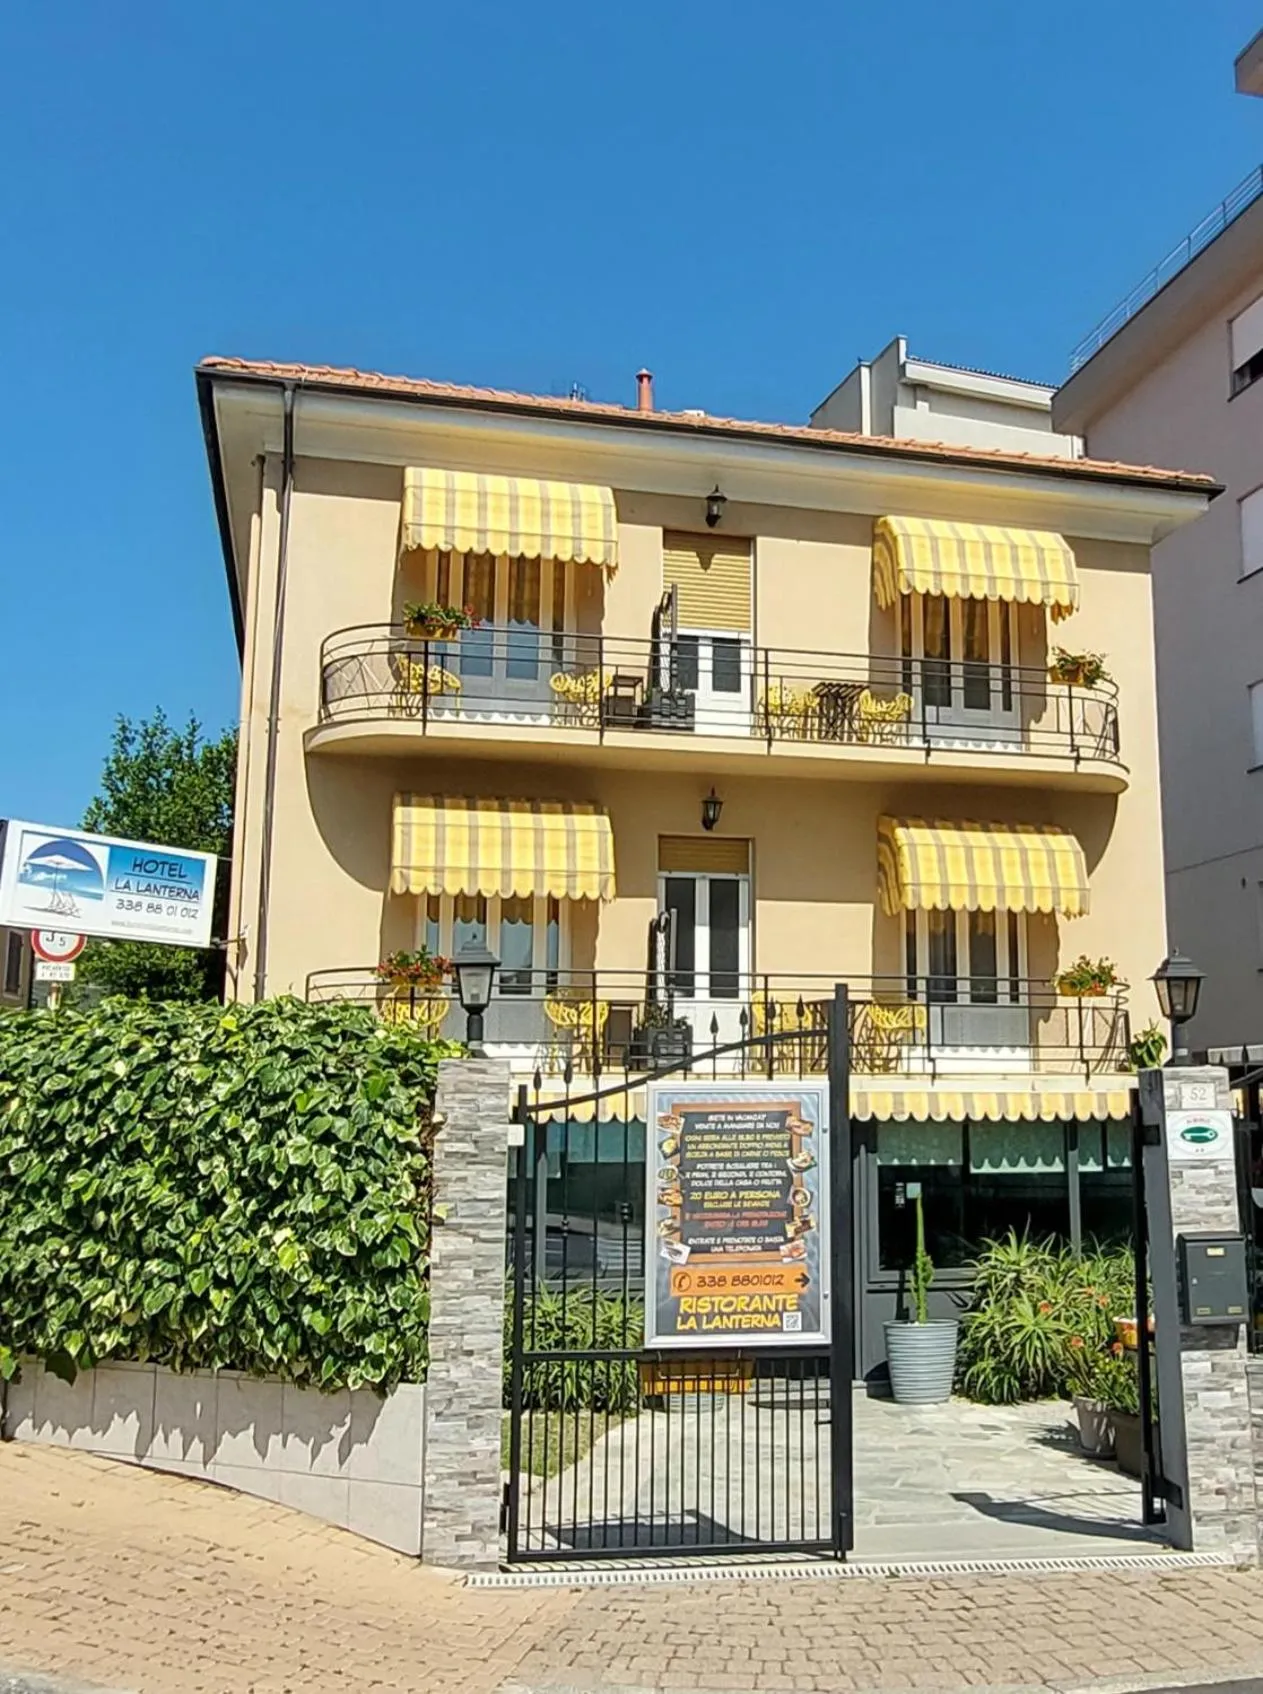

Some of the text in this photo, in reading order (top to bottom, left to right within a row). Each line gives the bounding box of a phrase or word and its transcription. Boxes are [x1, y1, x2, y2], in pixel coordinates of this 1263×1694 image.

[132, 856, 188, 878] HOTEL
[115, 878, 200, 900] LA LANTERNA
[116, 899, 199, 919] 338 88 01 012
[1190, 1087, 1207, 1101] 52
[689, 1190, 782, 1200] 20 EURO A PERSONA
[697, 1274, 785, 1288] 338 8801012
[679, 1293, 799, 1314] RISTORANTE
[676, 1313, 782, 1331] LA LANTERNA
